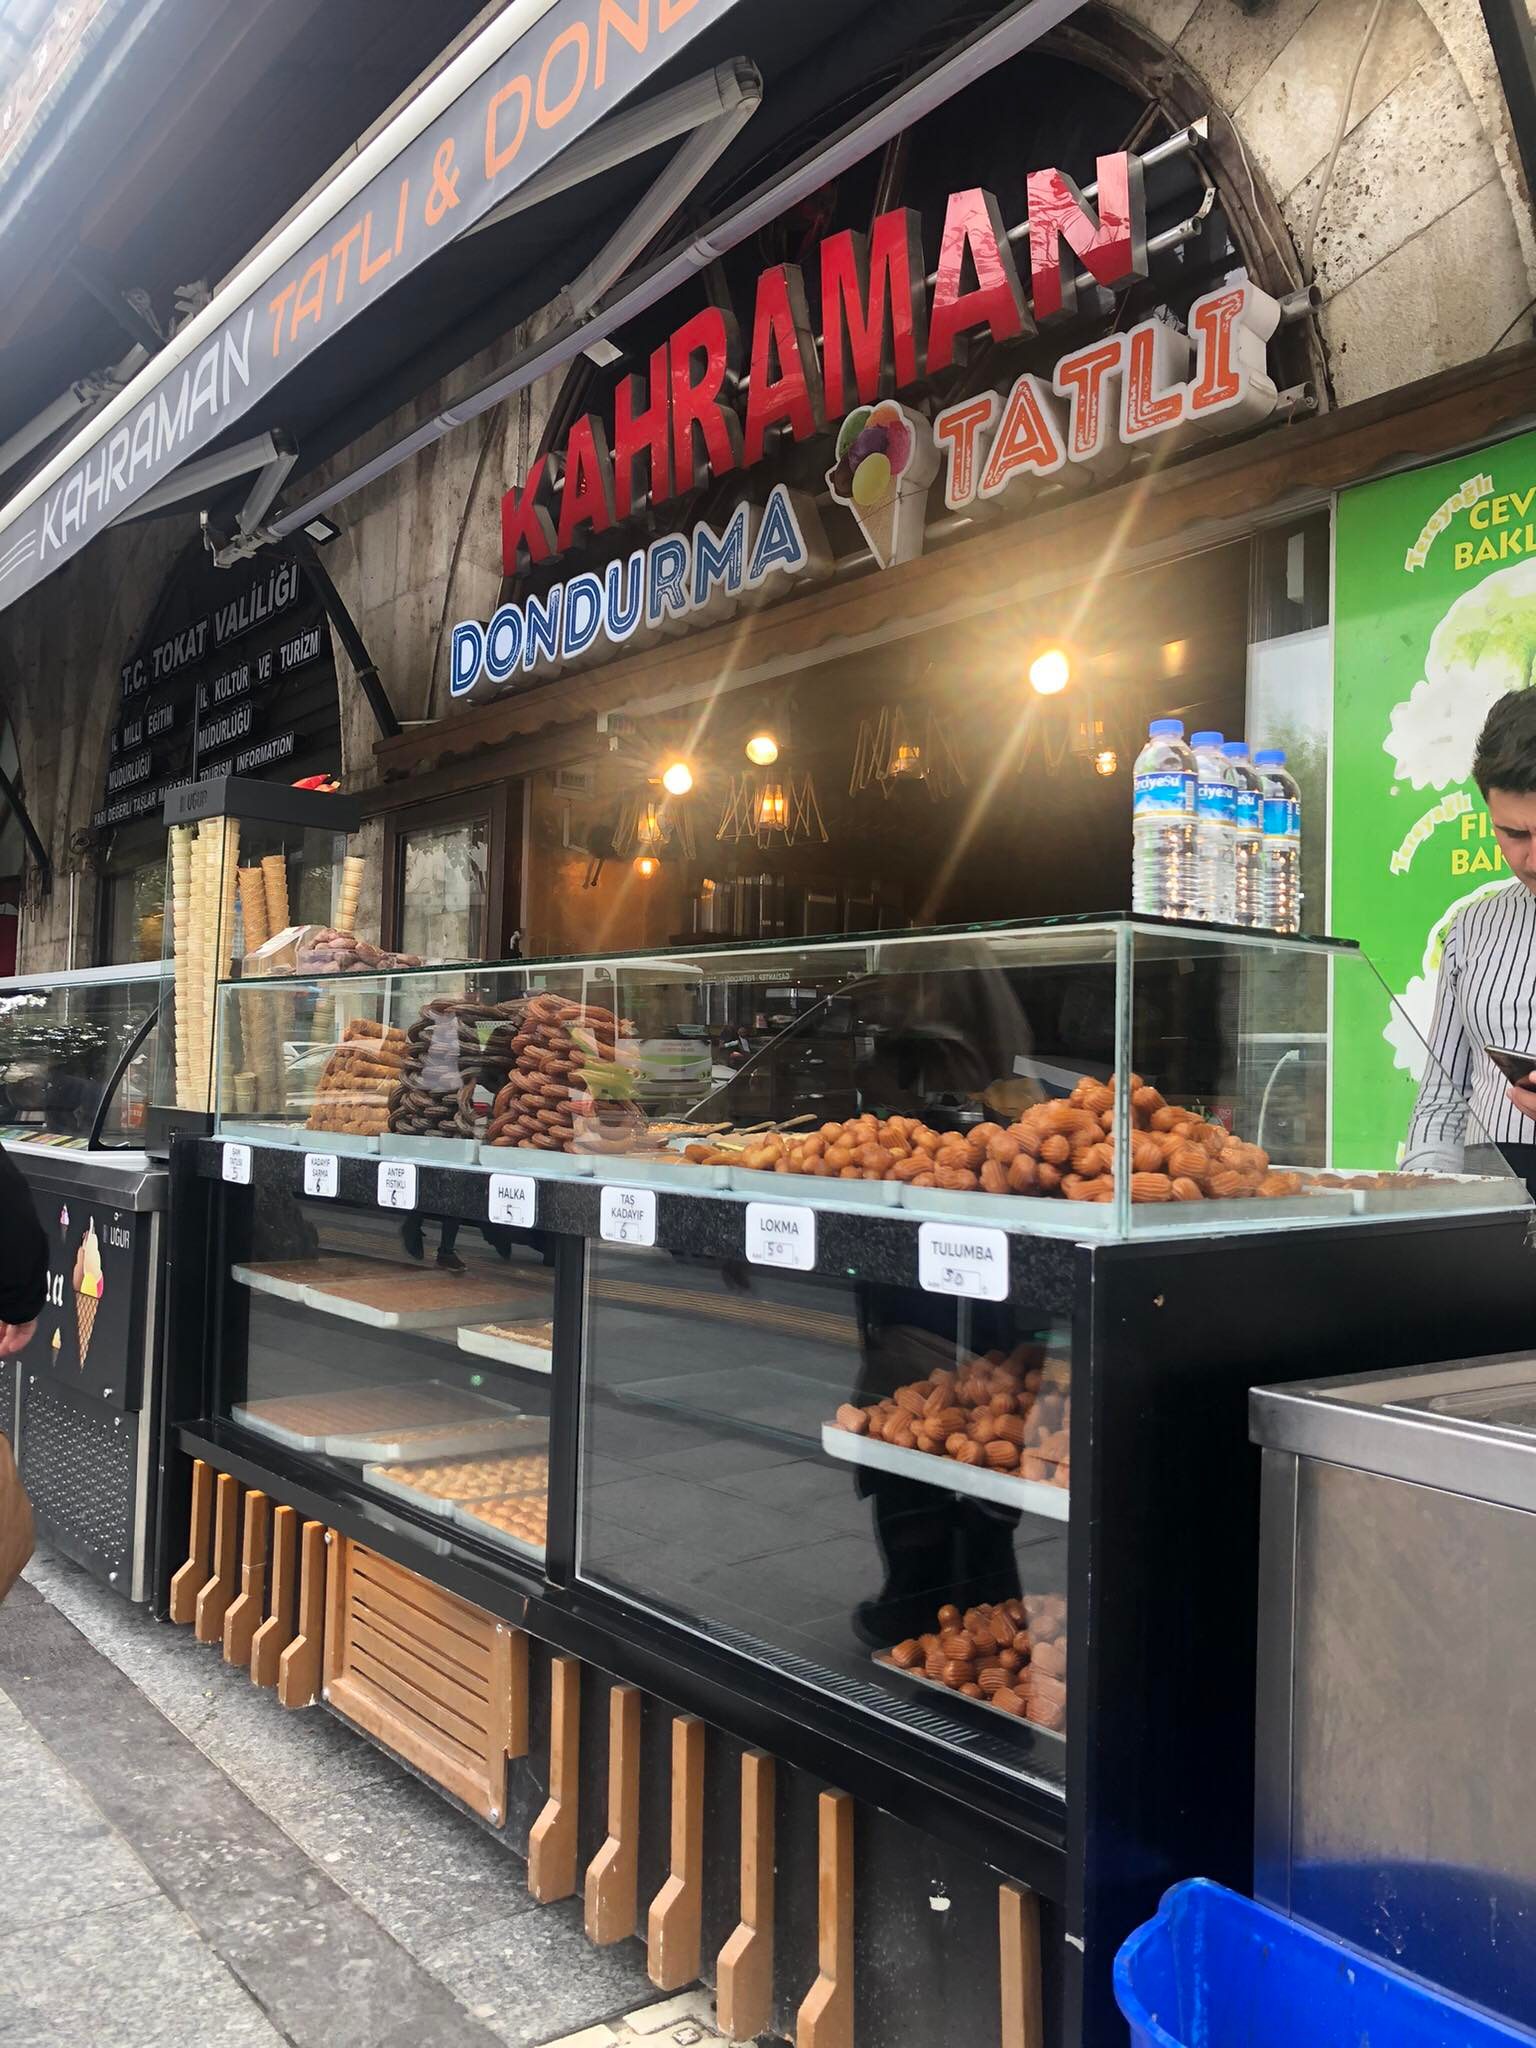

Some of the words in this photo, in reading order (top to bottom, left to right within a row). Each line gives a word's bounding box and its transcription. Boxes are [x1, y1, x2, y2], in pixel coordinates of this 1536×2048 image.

[40, 308, 254, 560] KAHRAMAN
[269, 177, 410, 358] TATLI
[424, 139, 461, 227] &
[502, 151, 1140, 577] KAHRAMAN
[451, 487, 803, 694] DONDURMA
[937, 286, 1246, 503] TATLI
[122, 659, 146, 695] T.C.
[152, 619, 208, 678] TOKAT
[214, 559, 298, 641] VALİLİĞİ
[214, 664, 249, 701] KÜLTÜR
[258, 653, 271, 680] VE
[280, 630, 319, 669] TURİZM
[236, 735, 293, 772] INFORMATION
[391, 1190, 397, 1205] 6
[498, 1186, 526, 1200] HALKA
[620, 1193, 635, 1207] TAŞ
[611, 1207, 644, 1220] KADAYIF
[619, 1222, 627, 1239] 6
[760, 1218, 799, 1235] LOKMA
[930, 1241, 993, 1262] TULUMBA
